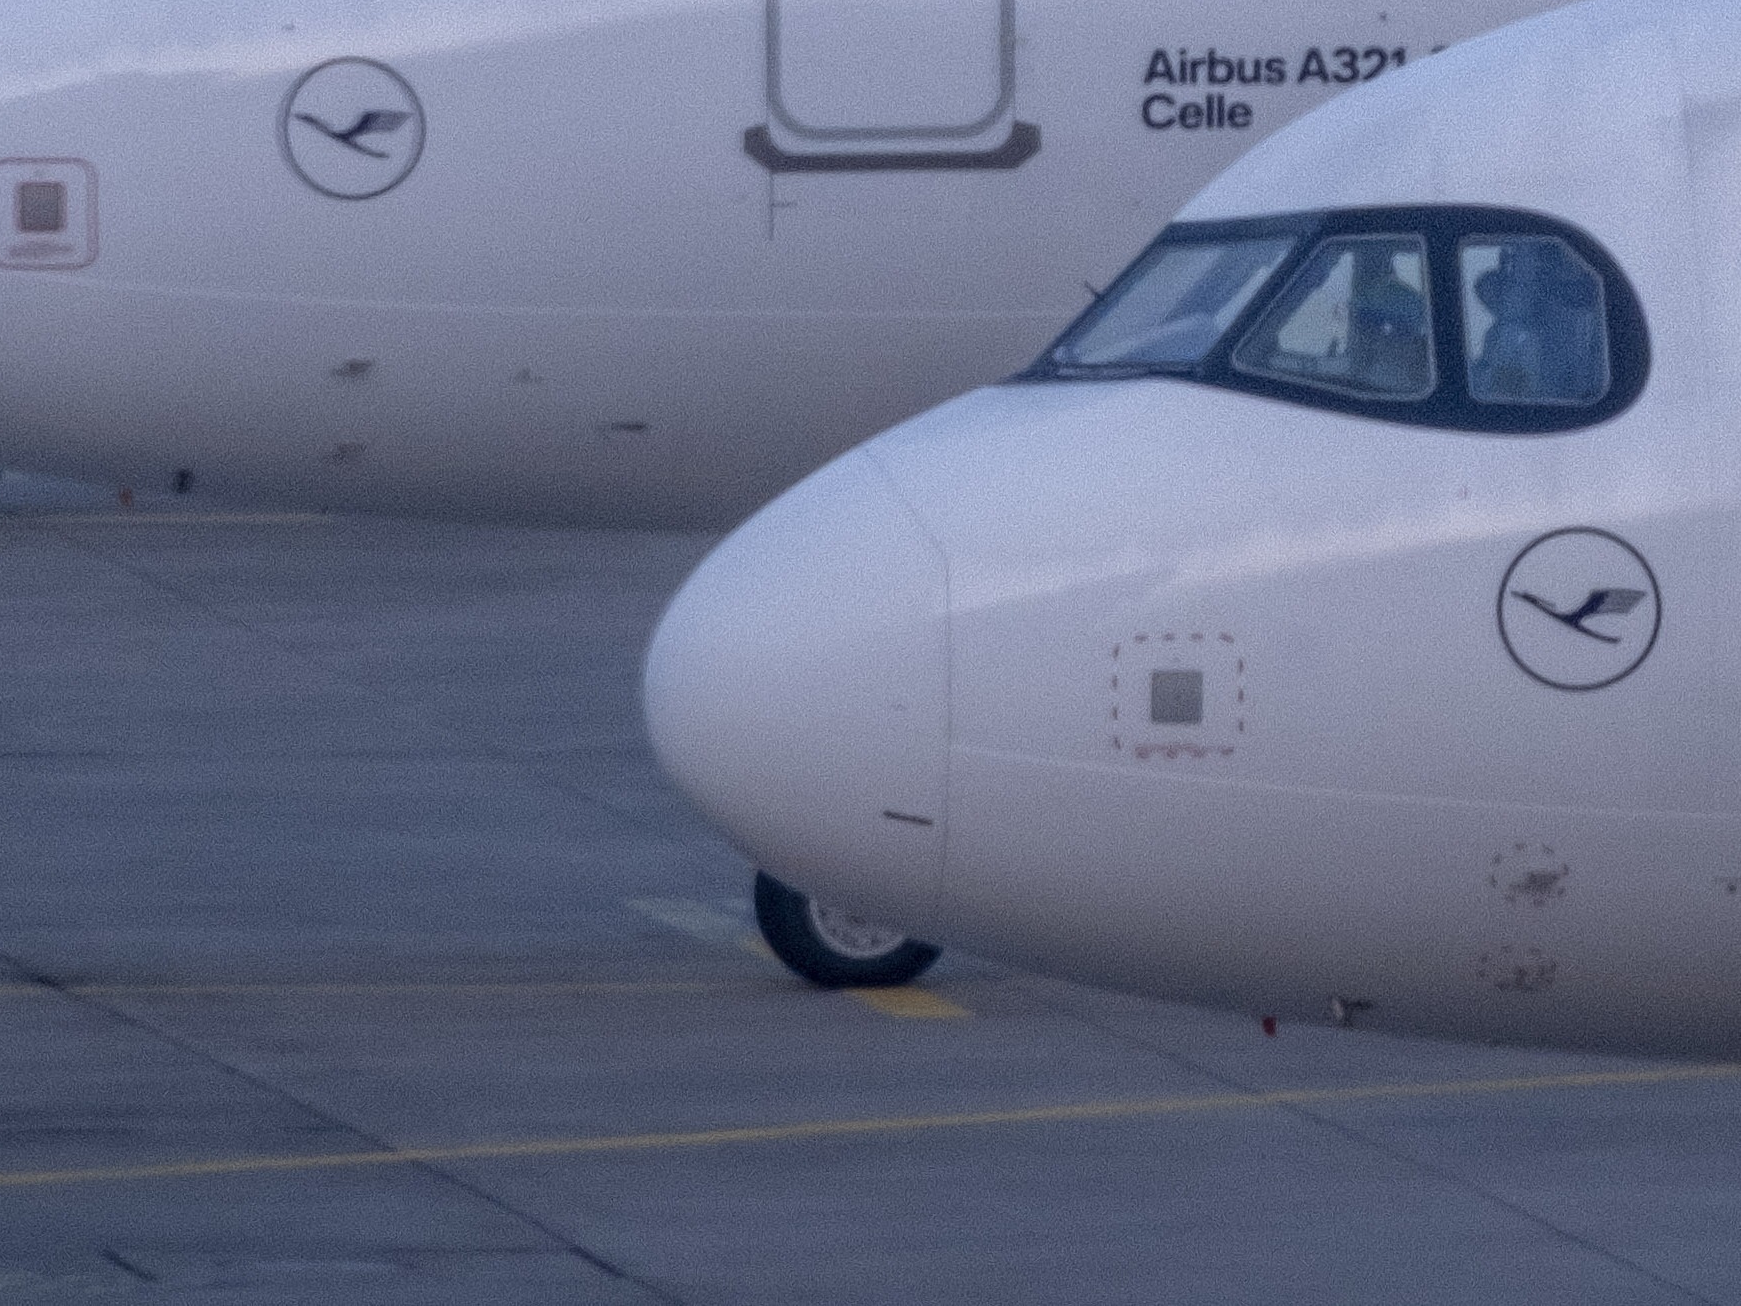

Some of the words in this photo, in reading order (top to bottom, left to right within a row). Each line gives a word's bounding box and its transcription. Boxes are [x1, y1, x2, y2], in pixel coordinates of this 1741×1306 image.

[1143, 47, 1286, 85] Airbus
[1297, 47, 1447, 85] A321
[1142, 93, 1252, 130] Celle
